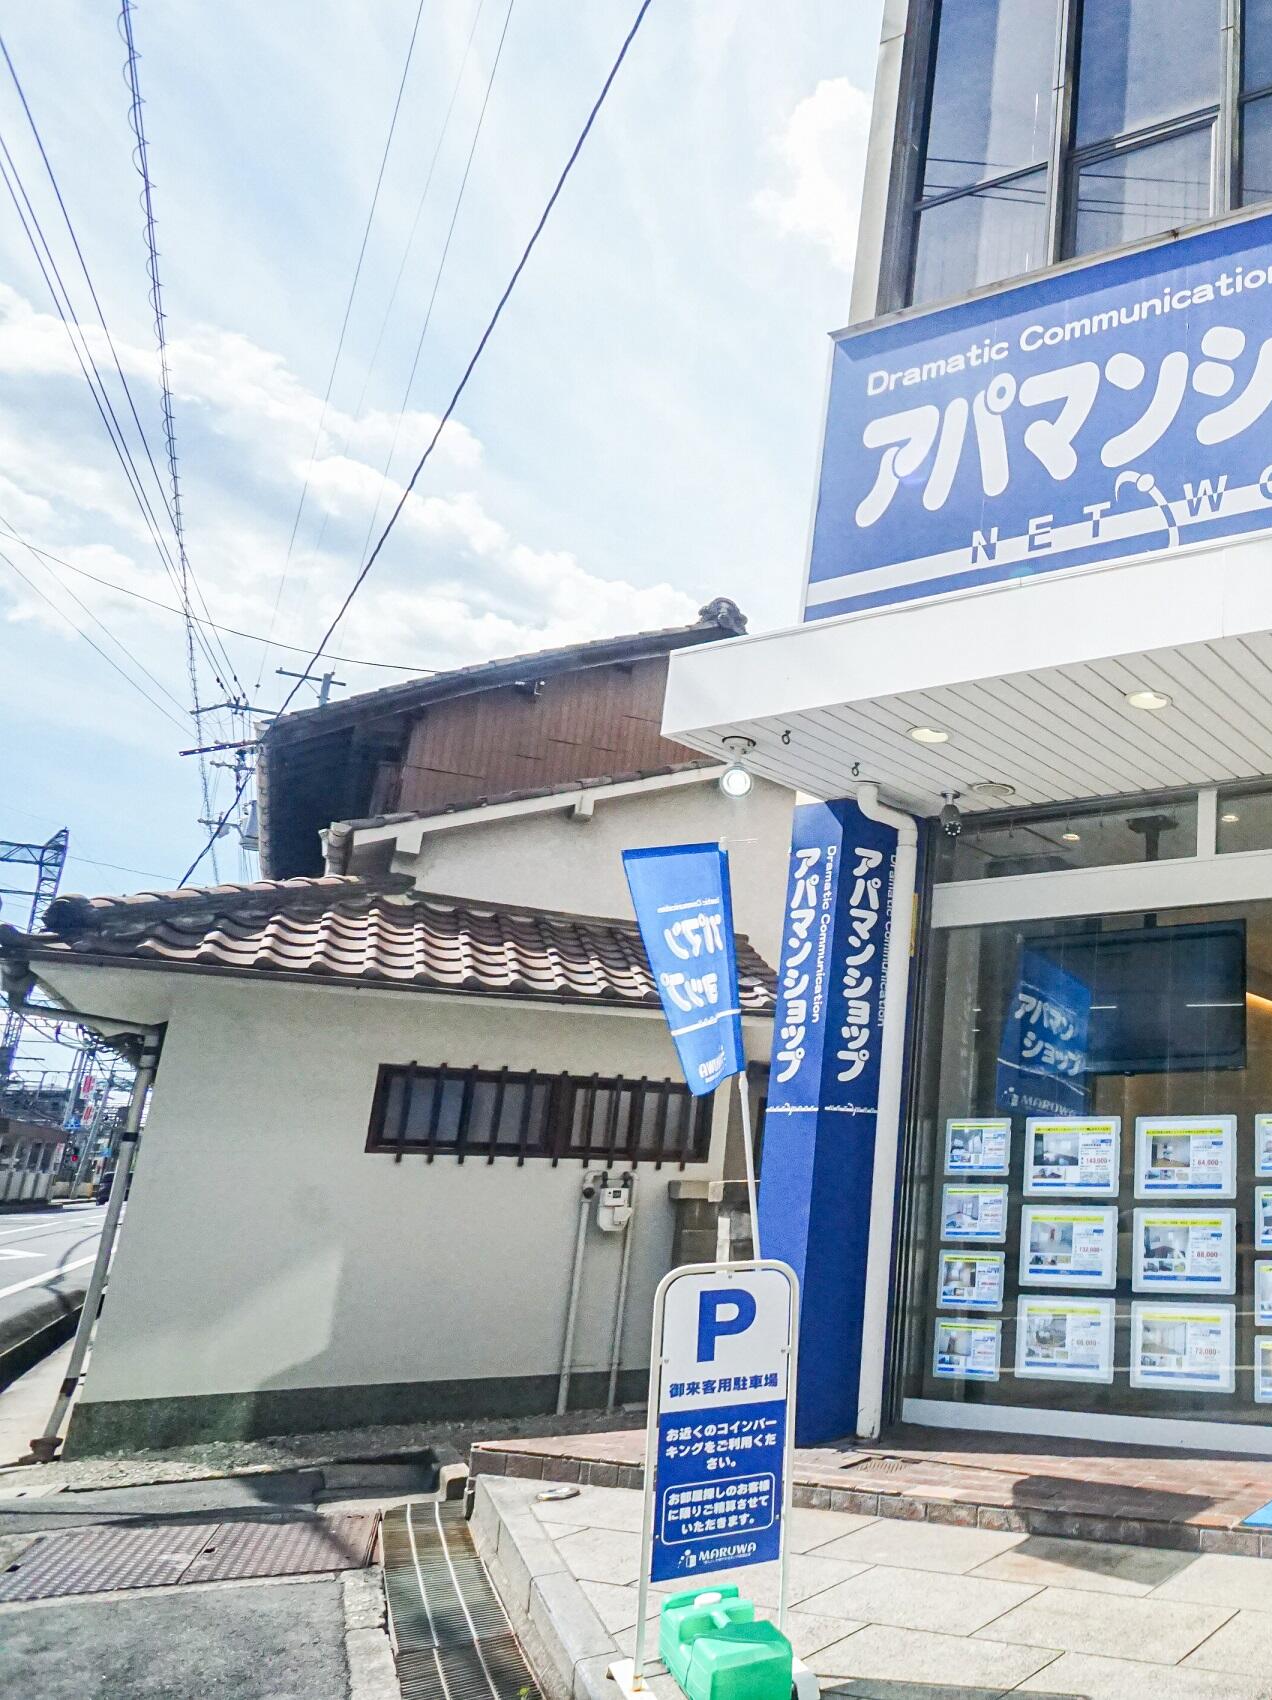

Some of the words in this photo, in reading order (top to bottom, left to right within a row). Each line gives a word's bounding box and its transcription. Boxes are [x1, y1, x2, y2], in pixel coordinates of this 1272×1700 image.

[867, 339, 1008, 396] Dramatic
[822, 846, 836, 910] Dramatic
[777, 847, 821, 1083] アパマンショップ
[812, 913, 830, 1023] Communication
[837, 847, 883, 1082] アパマンショップ
[696, 1288, 757, 1363] P
[669, 1372, 778, 1398] 御来客用駐車場
[665, 1433, 777, 1459] キングをご利用くだ
[706, 1456, 737, 1470] さい。
[681, 1513, 755, 1535] いただきます。
[699, 1542, 757, 1561] MARUWA
